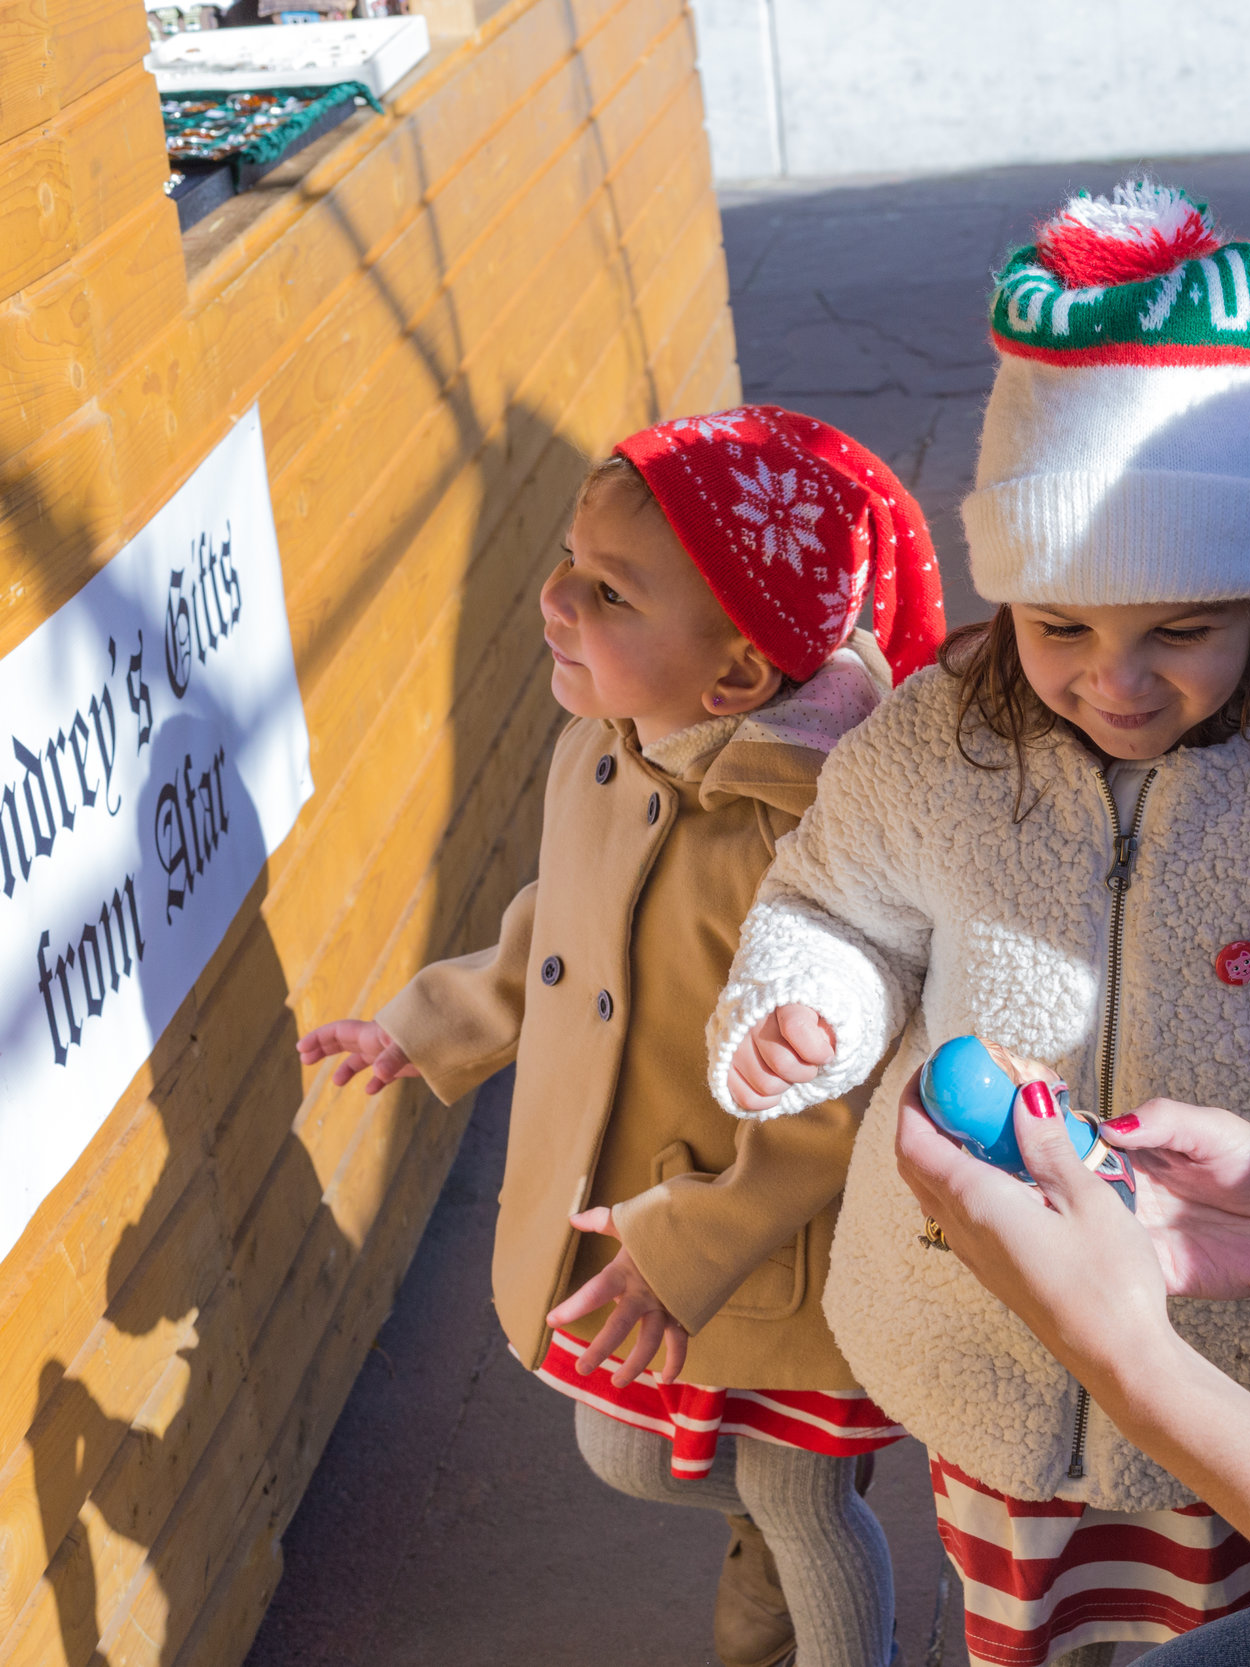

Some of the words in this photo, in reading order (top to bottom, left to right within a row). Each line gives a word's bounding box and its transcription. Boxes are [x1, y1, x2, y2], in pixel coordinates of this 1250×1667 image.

[0, 628, 153, 900] ndrey's
[165, 518, 242, 700] Gifts
[37, 872, 145, 1068] from
[155, 744, 229, 926] Afar
